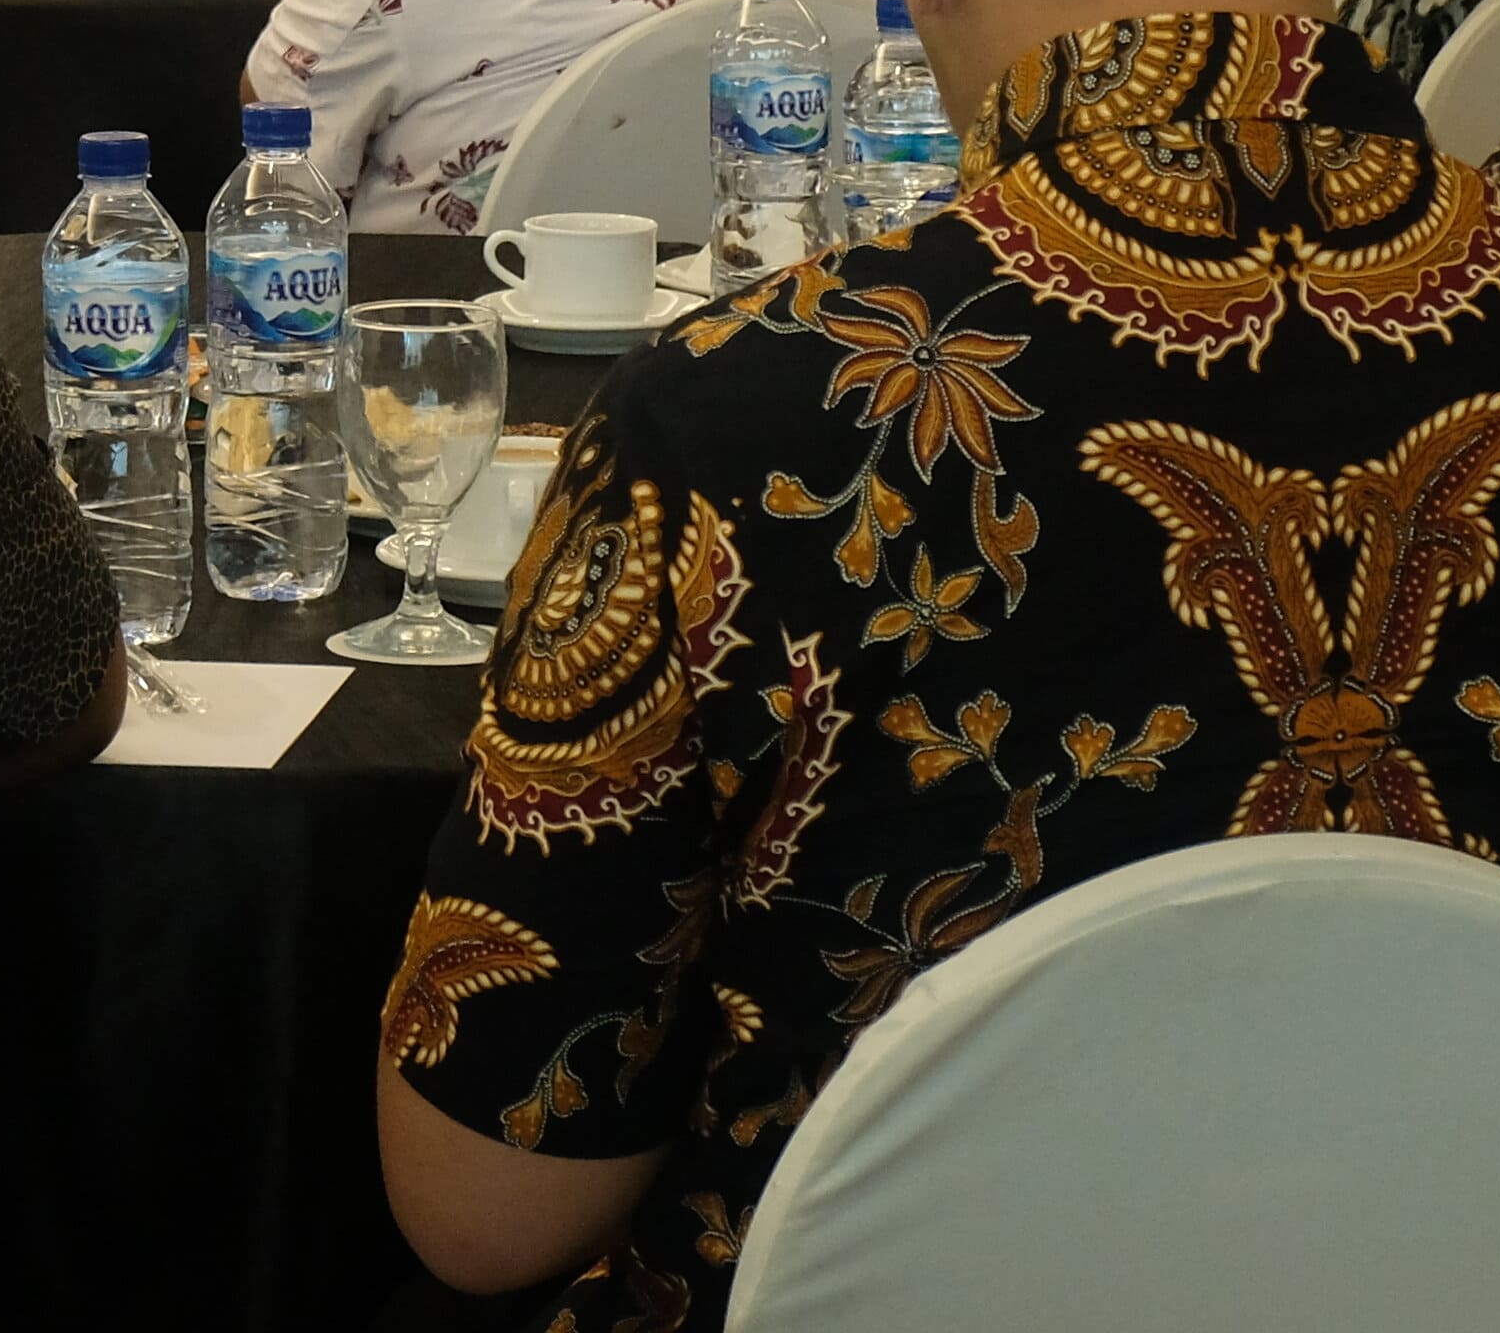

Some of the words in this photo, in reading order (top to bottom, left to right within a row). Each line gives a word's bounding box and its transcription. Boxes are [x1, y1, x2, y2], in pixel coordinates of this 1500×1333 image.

[755, 87, 826, 121] AQUA
[264, 266, 342, 305] AQUA
[65, 302, 155, 342] AQUA
